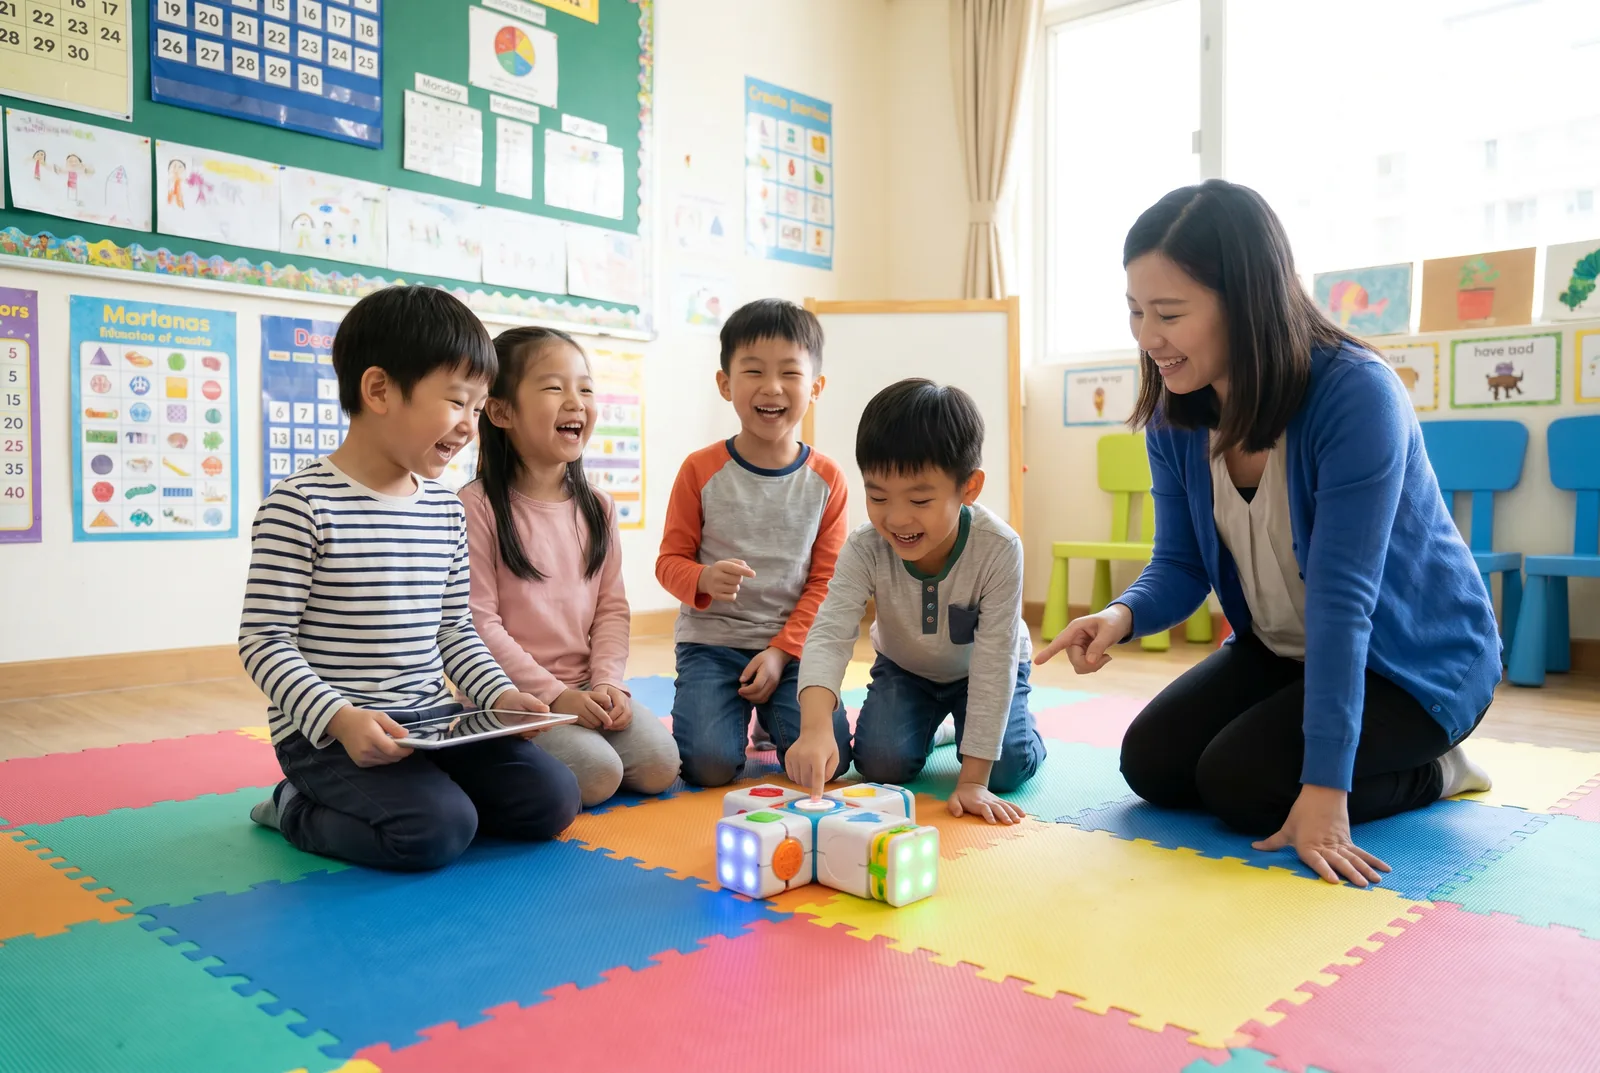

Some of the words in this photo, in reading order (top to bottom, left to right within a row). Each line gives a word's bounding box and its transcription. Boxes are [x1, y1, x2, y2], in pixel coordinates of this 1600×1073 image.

[101, 1, 118, 16] 17
[0, 1, 16, 17] 21
[33, 10, 54, 27] 22
[68, 19, 88, 35] 23
[100, 27, 121, 43] 24
[271, 0, 285, 11] 15
[303, 6, 317, 21] 16
[332, 14, 346, 28] 17
[360, 23, 374, 37] 18
[164, 1, 181, 16] 19
[199, 11, 219, 27] 20
[236, 21, 252, 36] 21
[268, 30, 286, 45] 22
[301, 38, 318, 54] 23
[332, 47, 348, 63] 24
[358, 56, 374, 70] 25
[0, 28, 20, 45] 28
[33, 37, 55, 52] 29
[68, 45, 89, 61] 30
[162, 38, 183, 55] 26
[200, 48, 219, 63] 27
[236, 56, 255, 71] 28
[269, 64, 286, 79] 29
[301, 72, 319, 87] 30
[423, 78, 461, 100] Monday
[0, 304, 30, 319] ors
[294, 328, 335, 349] Dec
[8, 347, 17, 359] 5
[1474, 346, 1504, 357] have
[8, 370, 17, 382] 5
[6, 394, 21, 406] 15
[275, 407, 284, 419] 6
[300, 408, 308, 419] 7
[324, 409, 333, 420] 8
[4, 417, 23, 429] 20
[4, 440, 24, 452] 25
[273, 433, 288, 445] 13
[298, 433, 312, 445] 14
[322, 434, 336, 446] 15
[5, 463, 23, 475] 35
[273, 458, 288, 470] 17
[4, 487, 25, 498] 40
